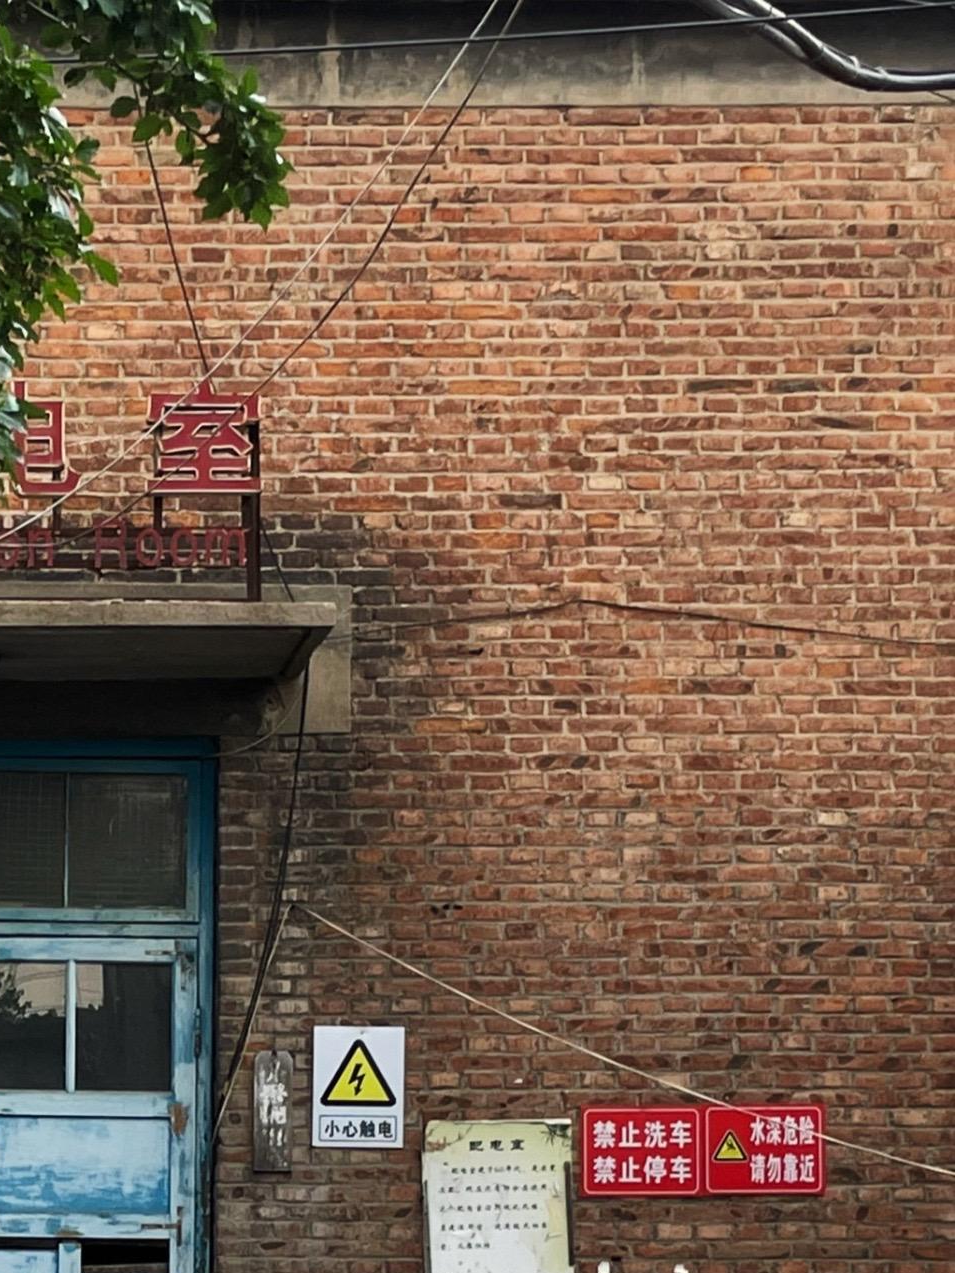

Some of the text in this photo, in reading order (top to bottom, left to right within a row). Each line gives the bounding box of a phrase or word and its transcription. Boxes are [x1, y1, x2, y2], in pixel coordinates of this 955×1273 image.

[95, 517, 249, 569] Room
[325, 1119, 393, 1138] 小心触电
[593, 1120, 693, 1149] 禁止洗车
[750, 1115, 816, 1146] 水深危险
[469, 1139, 525, 1152] 配电室
[593, 1155, 693, 1185] 禁止停车
[750, 1153, 816, 1184] 请勿靠近
